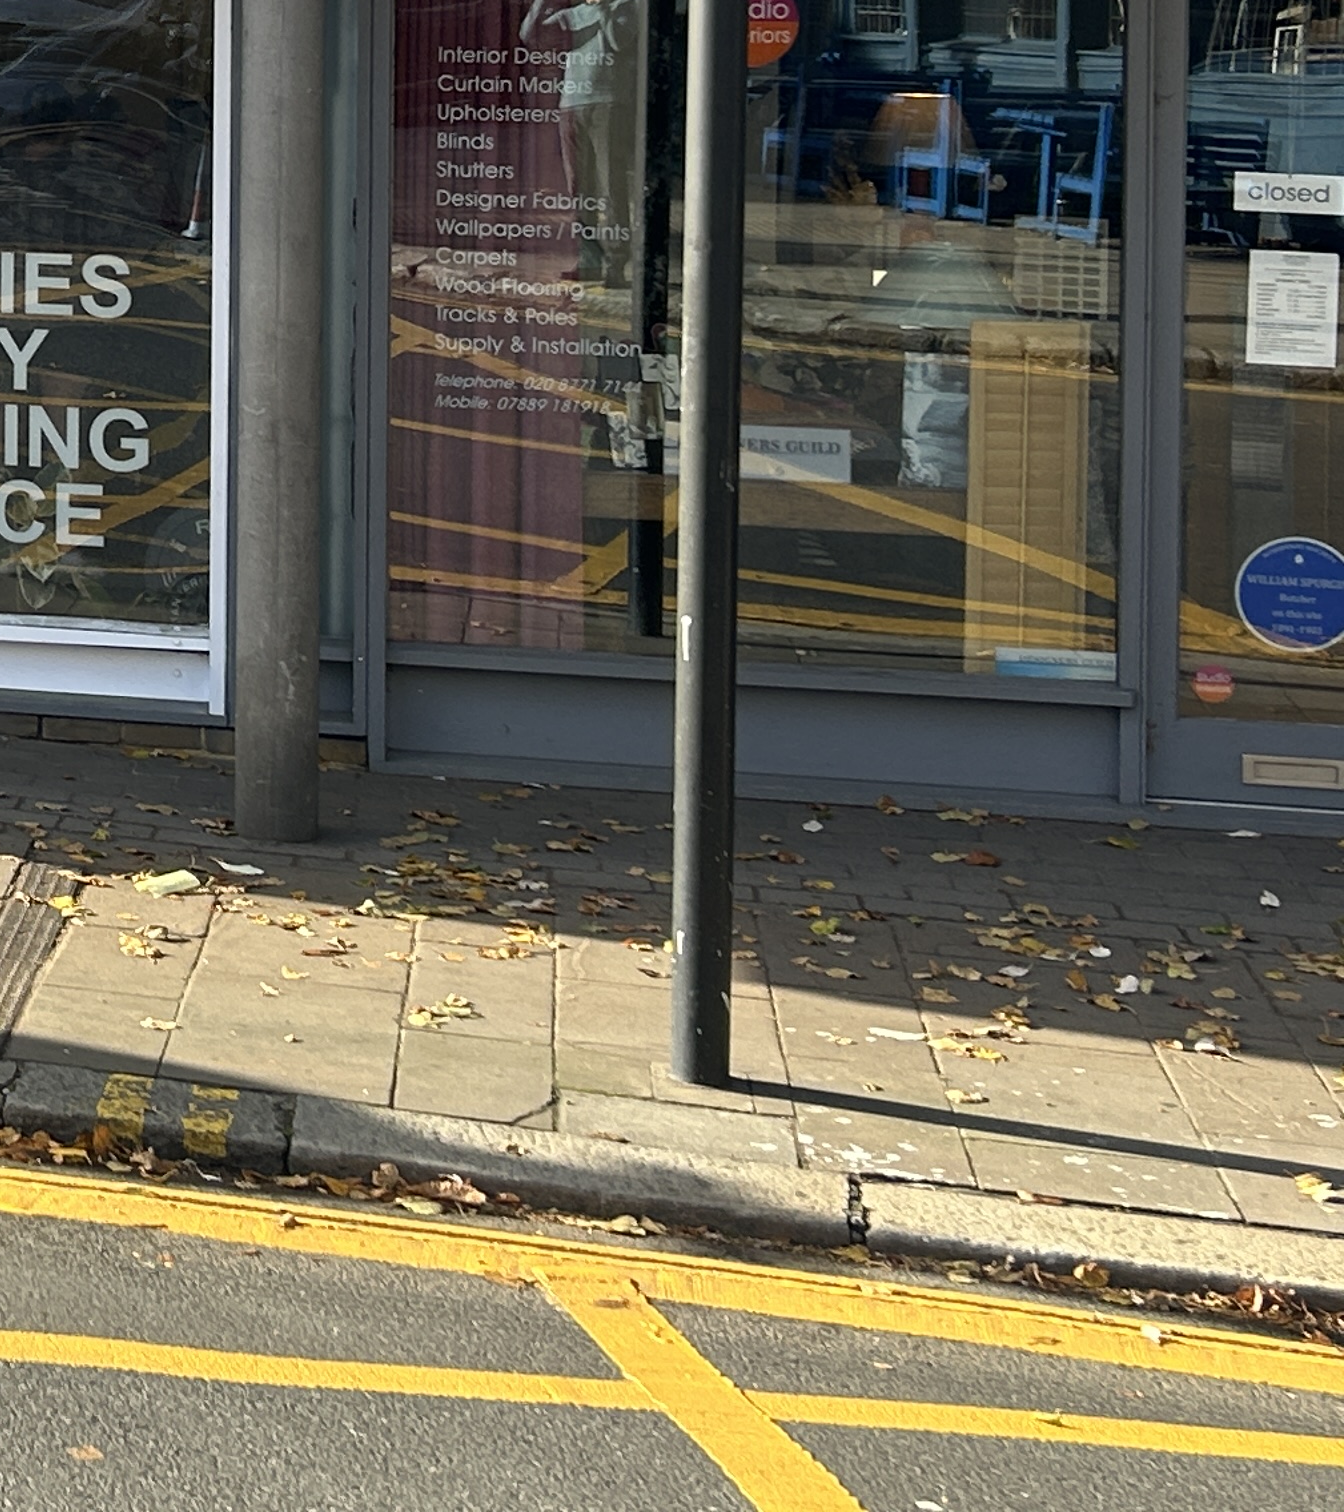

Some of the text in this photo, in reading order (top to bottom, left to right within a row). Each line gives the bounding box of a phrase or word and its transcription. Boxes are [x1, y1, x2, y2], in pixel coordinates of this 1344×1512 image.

[437, 46, 614, 69] Interior Designers
[437, 74, 593, 94] Curtain Makers
[436, 103, 561, 124] Upholsterers
[436, 131, 494, 150] Blinds
[436, 160, 514, 179] Shutters
[436, 189, 607, 211] Designer Fabrics
[1247, 182, 1330, 203] closed
[436, 218, 552, 240] Wallpapers
[571, 222, 630, 241] Paints
[435, 247, 517, 267] Carpets
[435, 276, 585, 301] Wood Flooring
[435, 304, 578, 326] Tracks & Poles
[434, 333, 642, 357] Supply & Installation
[523, 376, 555, 390] 020
[561, 377, 597, 393] 8771
[786, 440, 841, 455] GUILD
